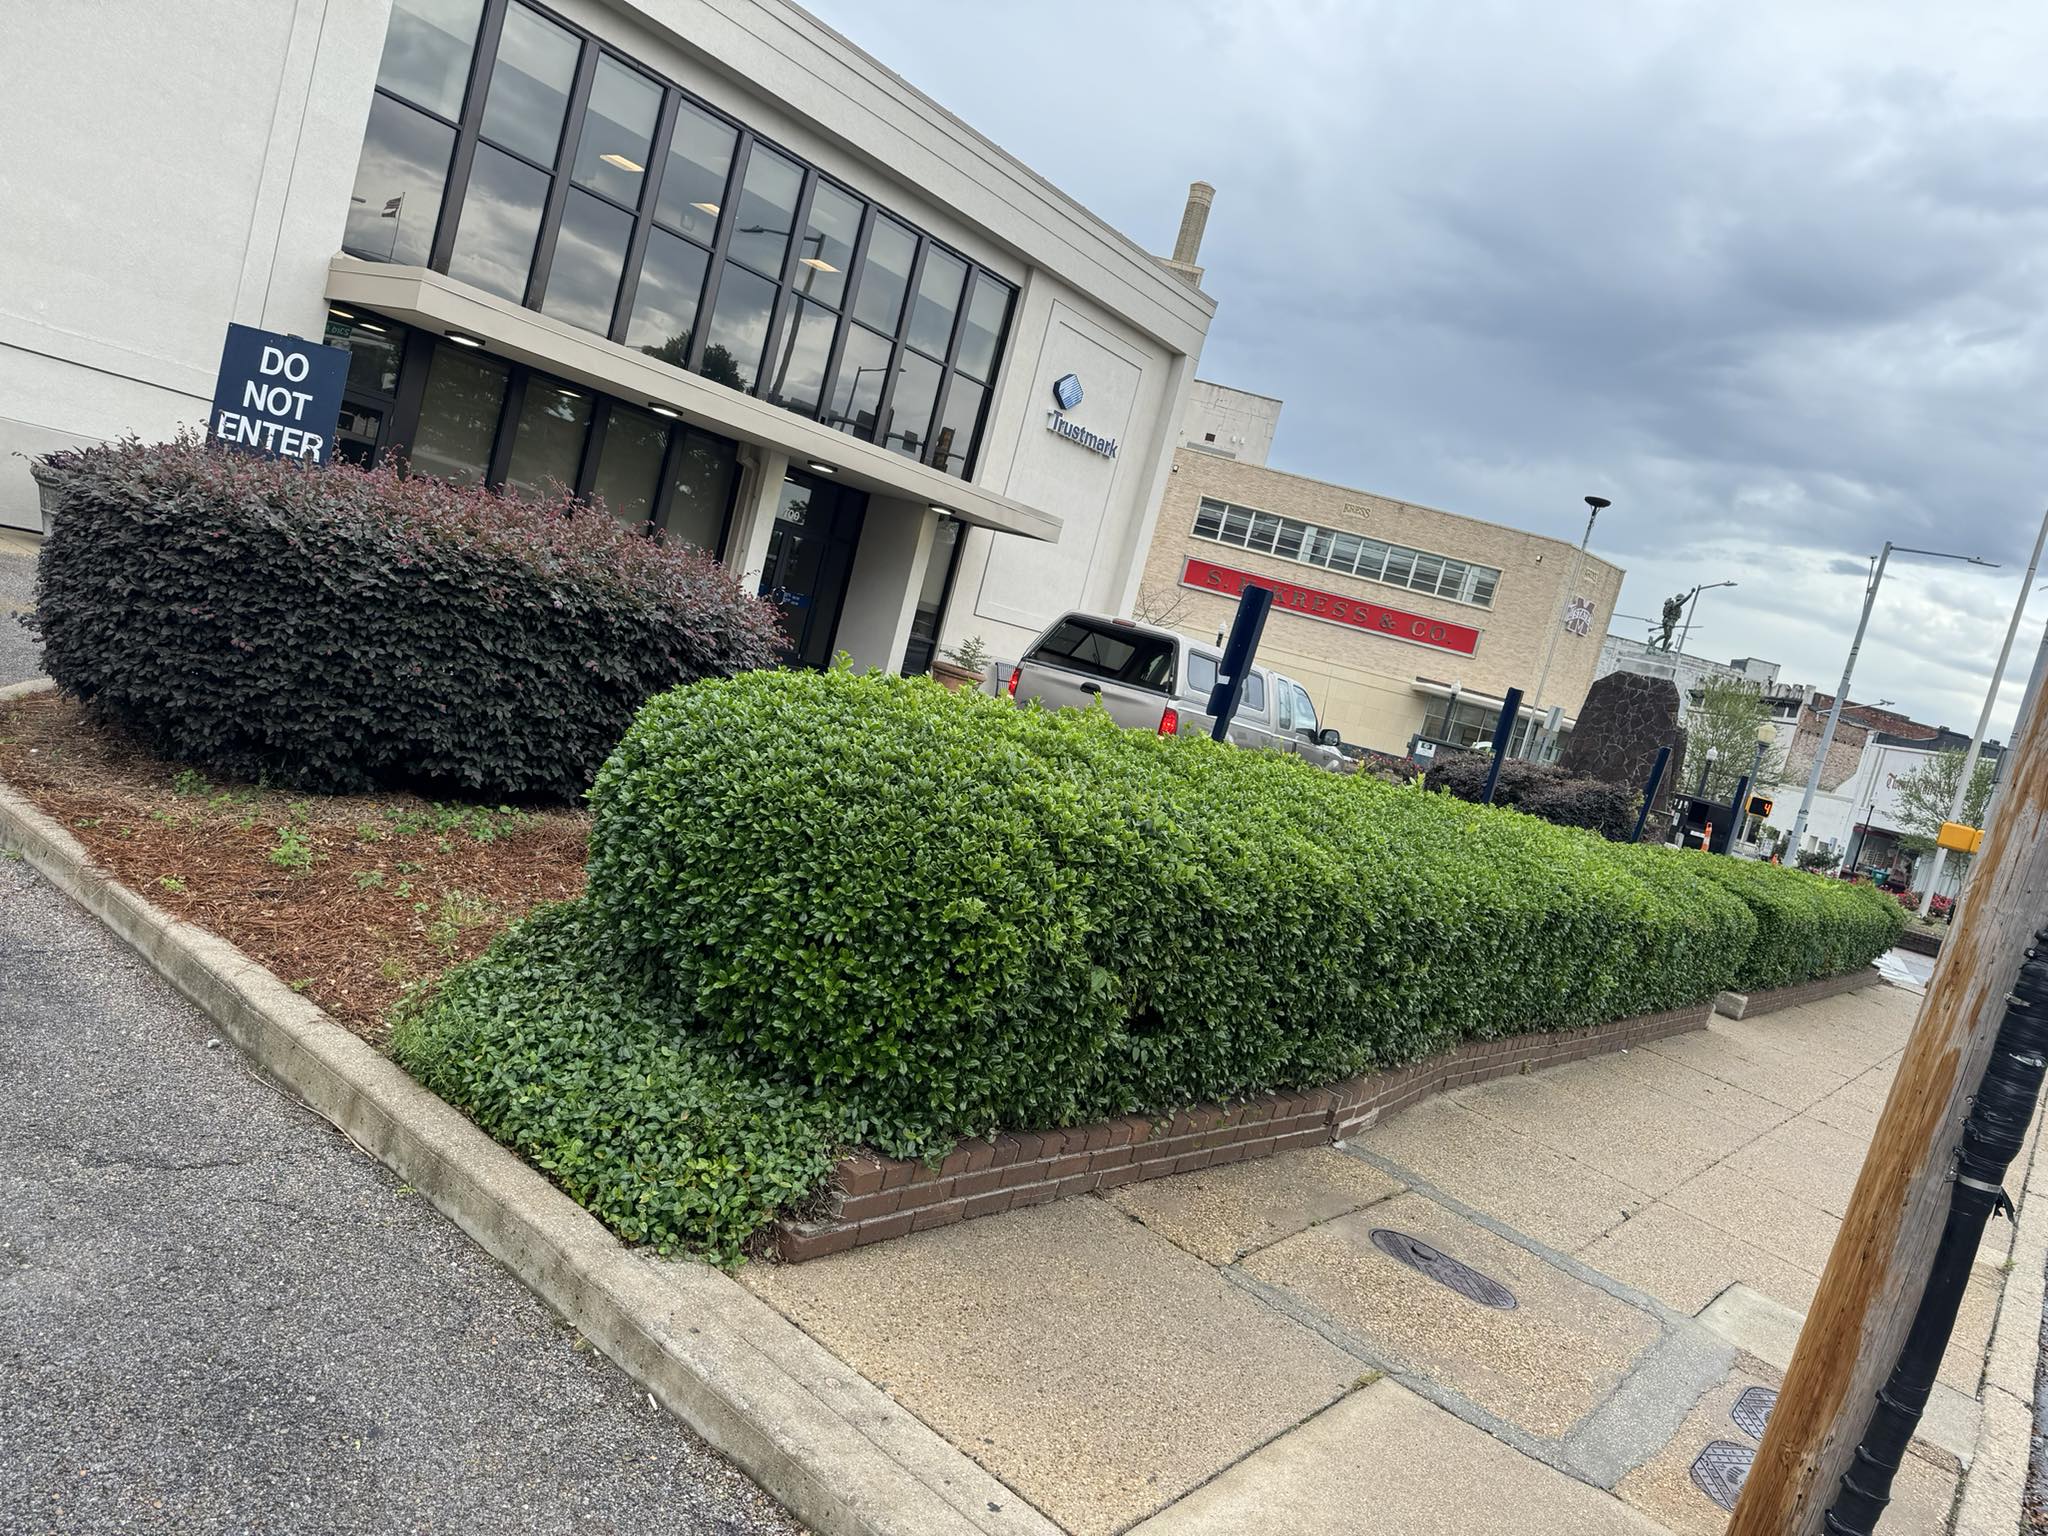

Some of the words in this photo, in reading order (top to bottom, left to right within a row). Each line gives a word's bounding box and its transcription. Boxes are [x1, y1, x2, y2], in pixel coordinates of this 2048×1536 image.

[259, 346, 310, 382] DO
[242, 380, 313, 421] NOT
[217, 411, 324, 463] ENTER
[1050, 410, 1118, 458] Trustmark
[1206, 569, 1229, 589] S.
[1272, 585, 1369, 623] KRESS
[1379, 613, 1397, 630] &
[1410, 621, 1452, 645] CO.
[1764, 803, 1771, 815] 4
